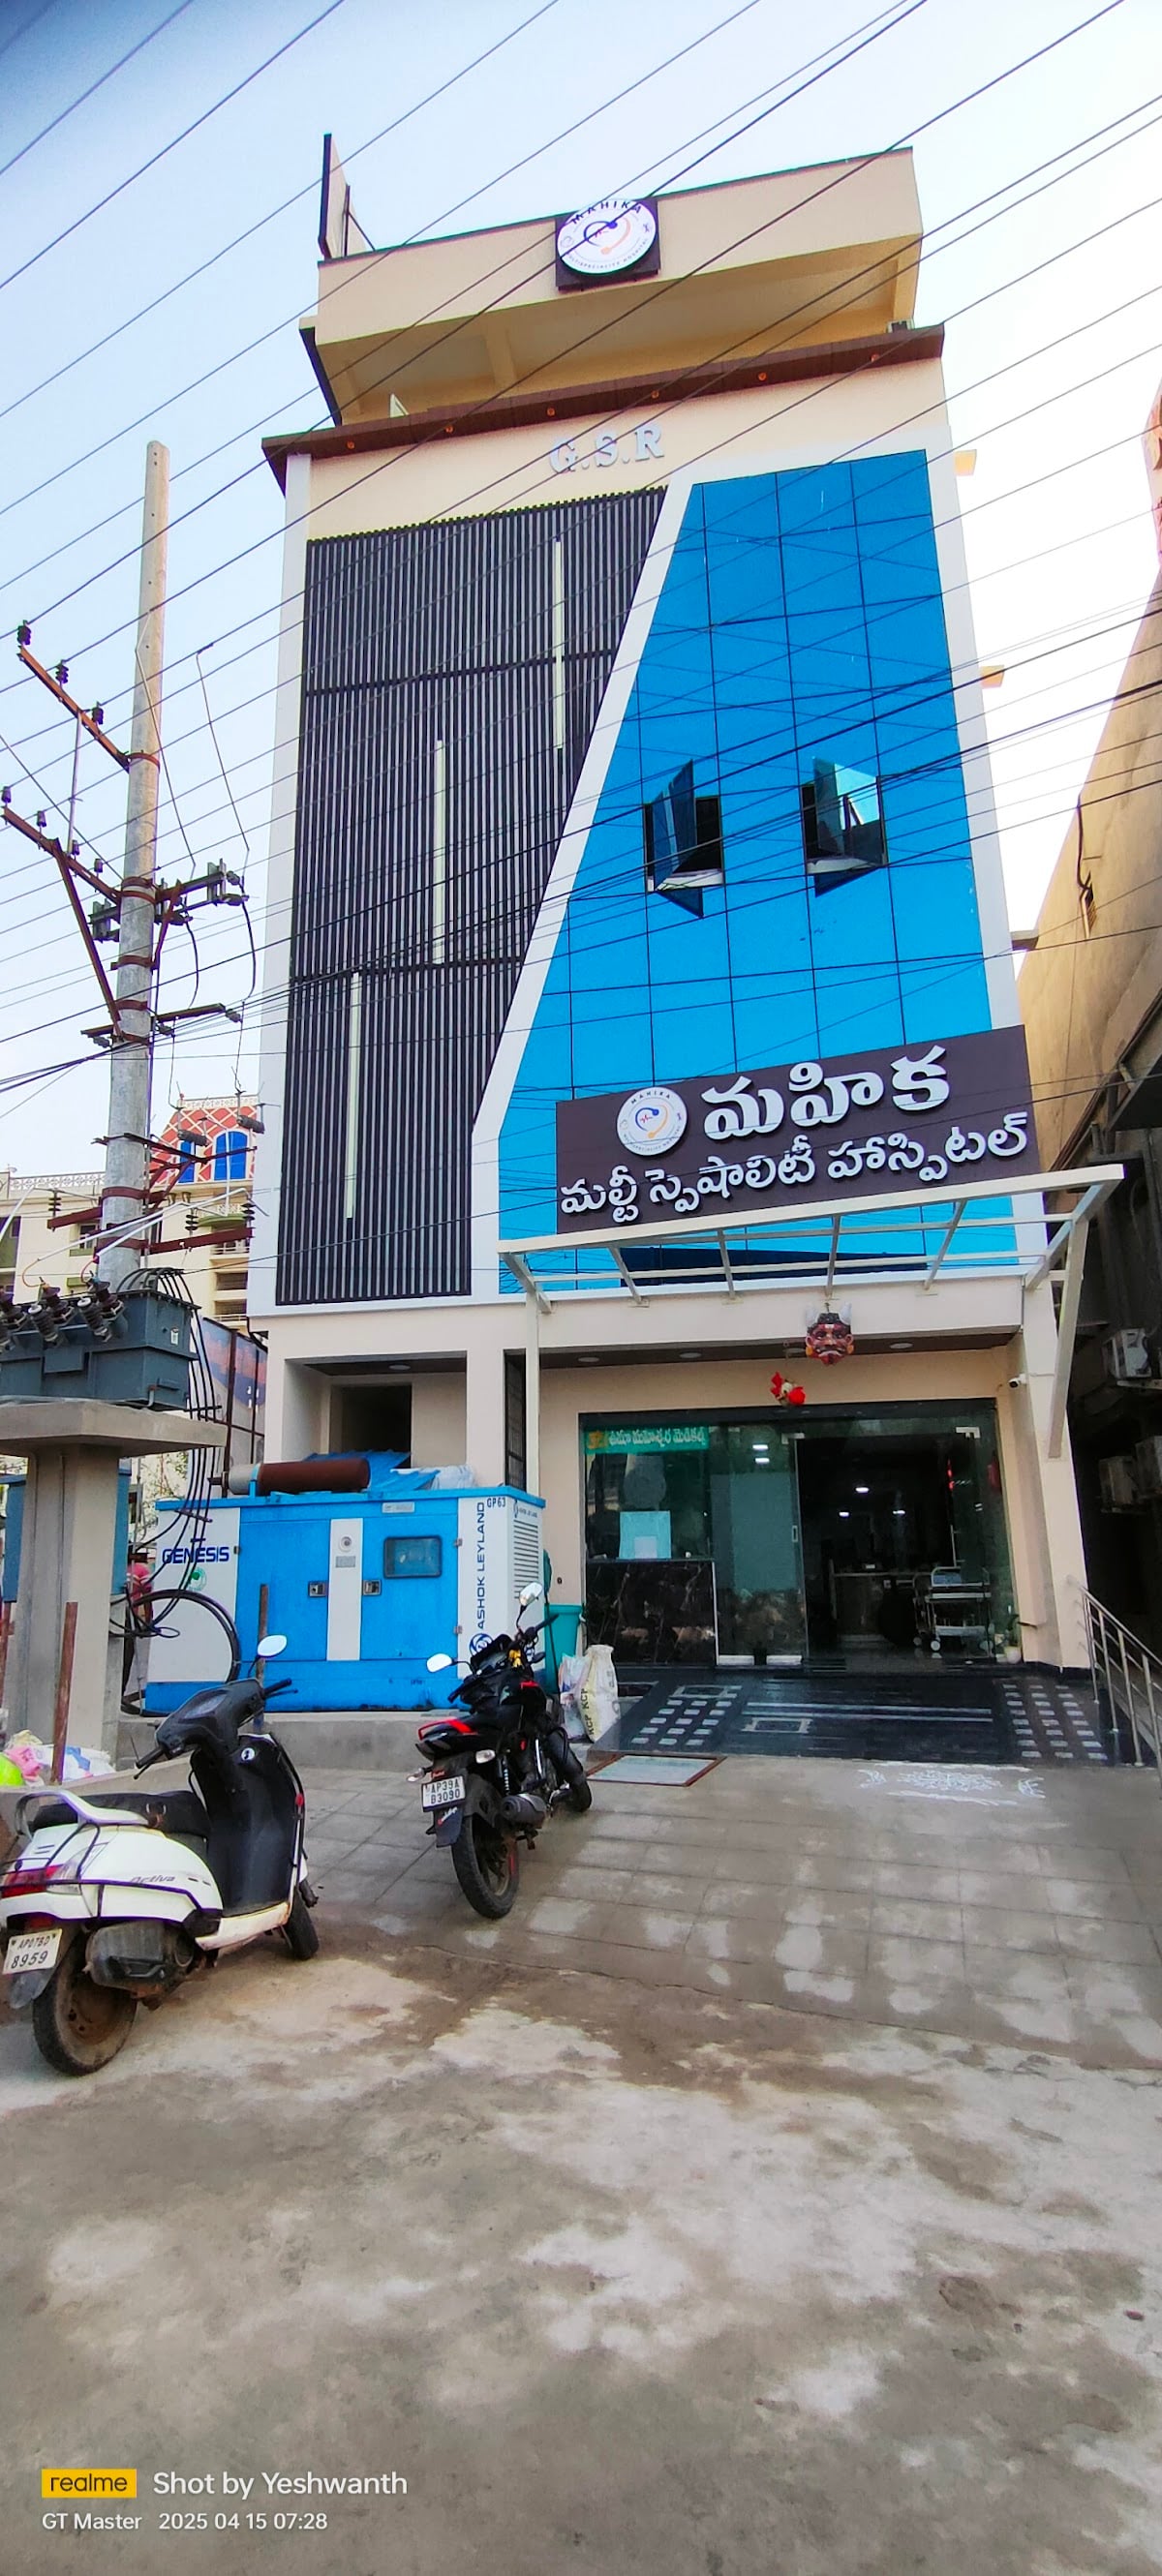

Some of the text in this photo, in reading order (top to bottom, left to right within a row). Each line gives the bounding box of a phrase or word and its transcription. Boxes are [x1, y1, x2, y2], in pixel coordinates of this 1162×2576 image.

[550, 424, 664, 473] G.S.R
[631, 1090, 670, 1105] MAHIKA
[701, 1046, 950, 1140] మహిక
[561, 1111, 1027, 1223] మల్టీ స్పెషాలిటీ హాస్పిటల్
[486, 1497, 506, 1508] GP63
[163, 1547, 229, 1563] GENESIS
[431, 1778, 460, 1794] AP39A
[431, 1788, 461, 1804] B3090
[11, 1951, 48, 1969] 8959
